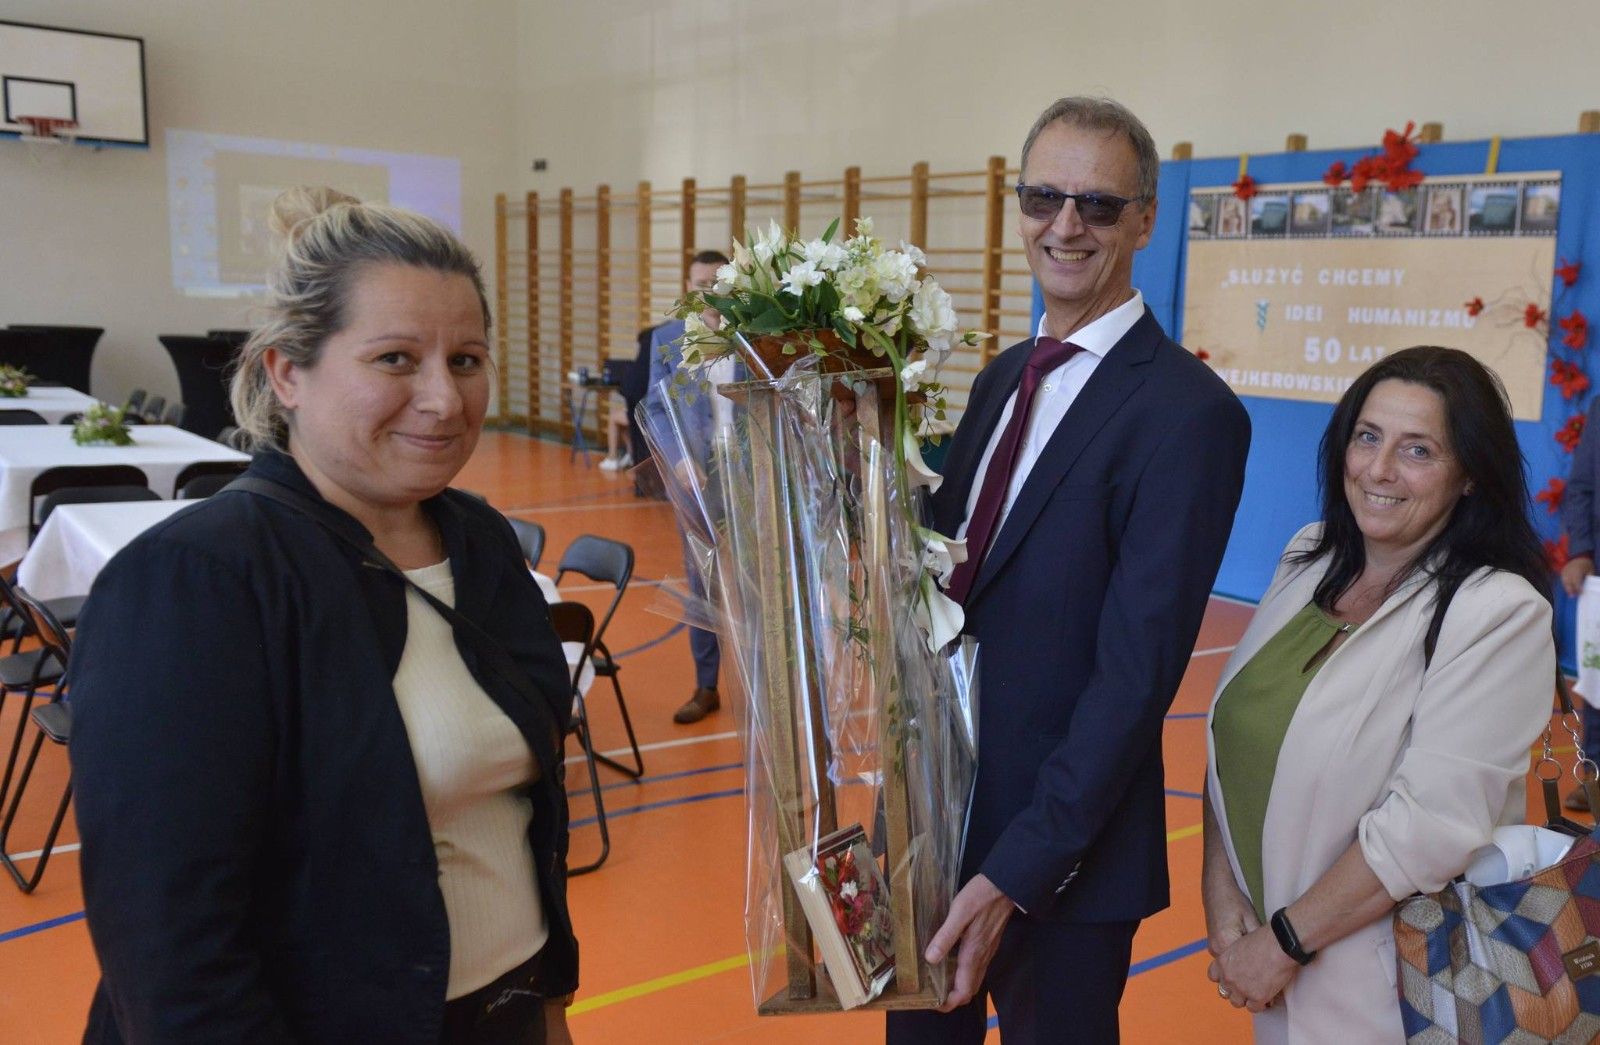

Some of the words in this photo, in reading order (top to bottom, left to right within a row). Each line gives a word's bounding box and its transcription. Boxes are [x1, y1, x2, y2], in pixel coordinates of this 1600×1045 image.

[1318, 267, 1405, 287] CHCEMY
[1285, 304, 1323, 322] IDEI
[1348, 306, 1477, 329] HUMANIZMU
[1304, 336, 1342, 364] 50
